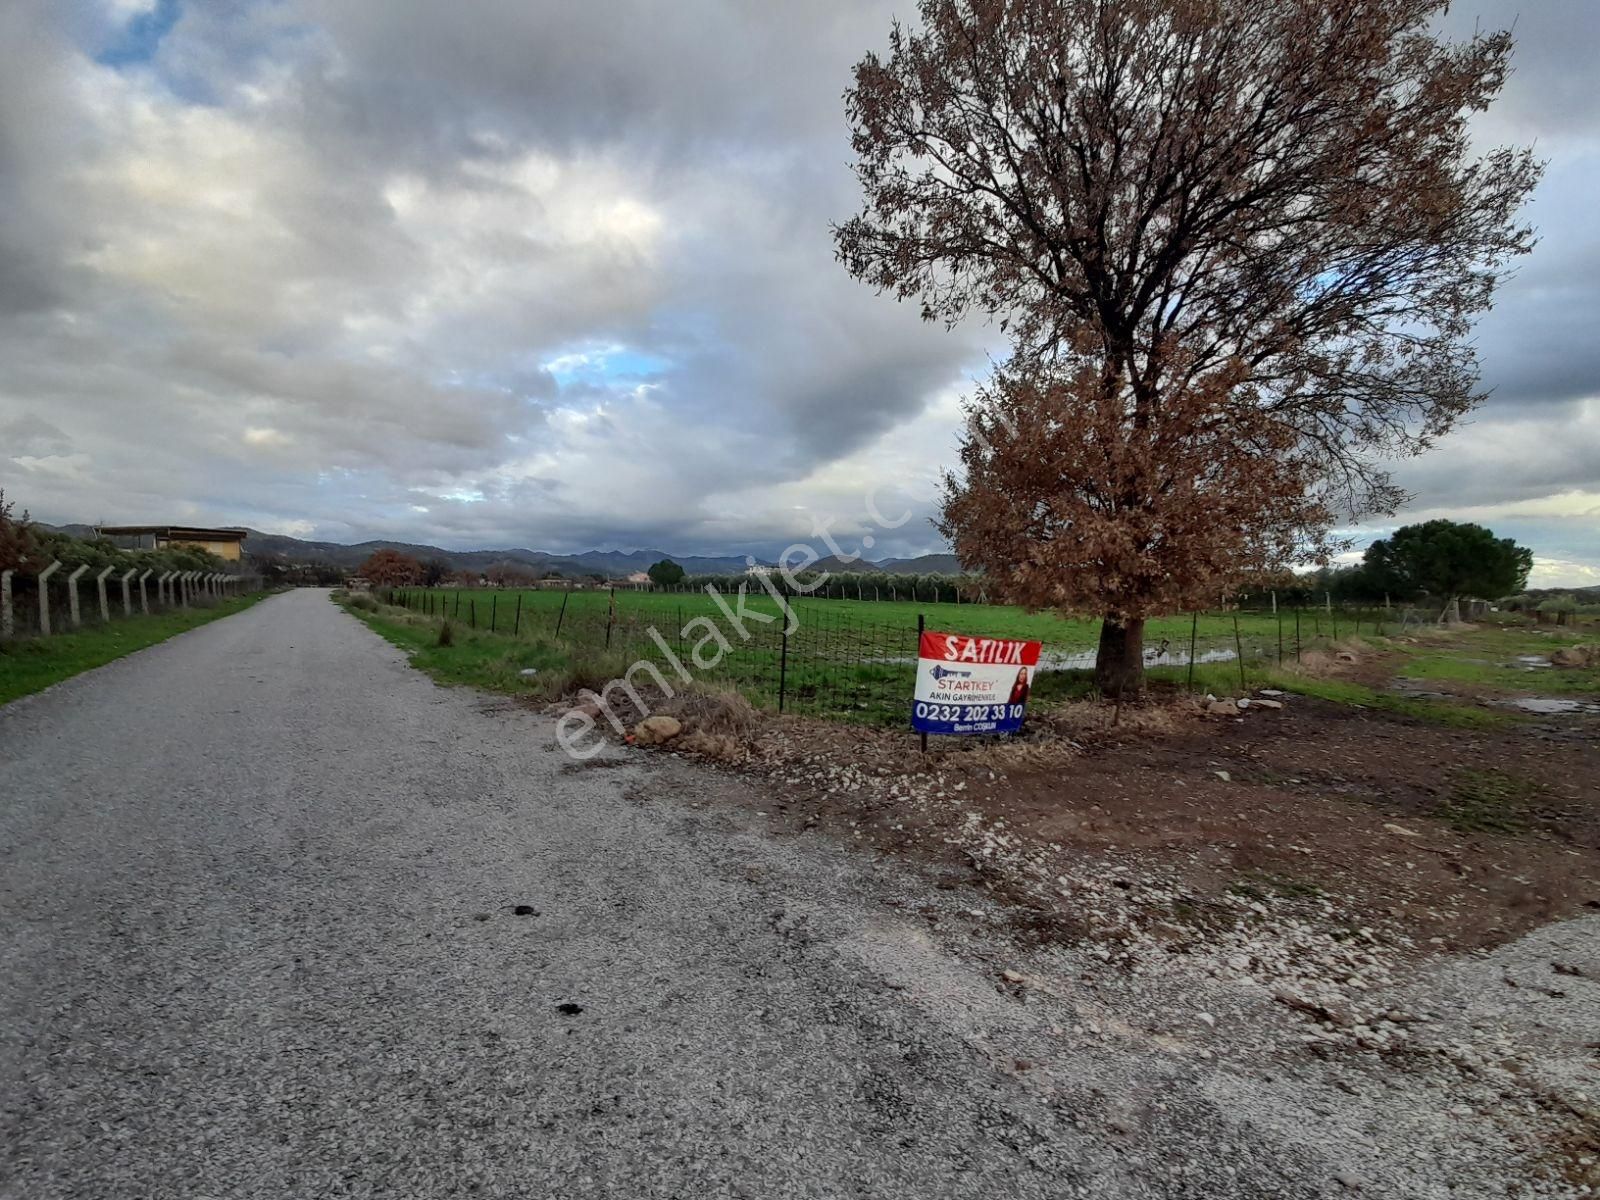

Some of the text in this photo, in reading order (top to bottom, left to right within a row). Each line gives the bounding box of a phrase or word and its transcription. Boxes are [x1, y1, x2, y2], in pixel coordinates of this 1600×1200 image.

[944, 635, 1026, 664] SATILIK
[938, 679, 994, 691] STARTKEY
[929, 691, 951, 701] AKIN
[916, 702, 1023, 721] 0232 202 33 10
